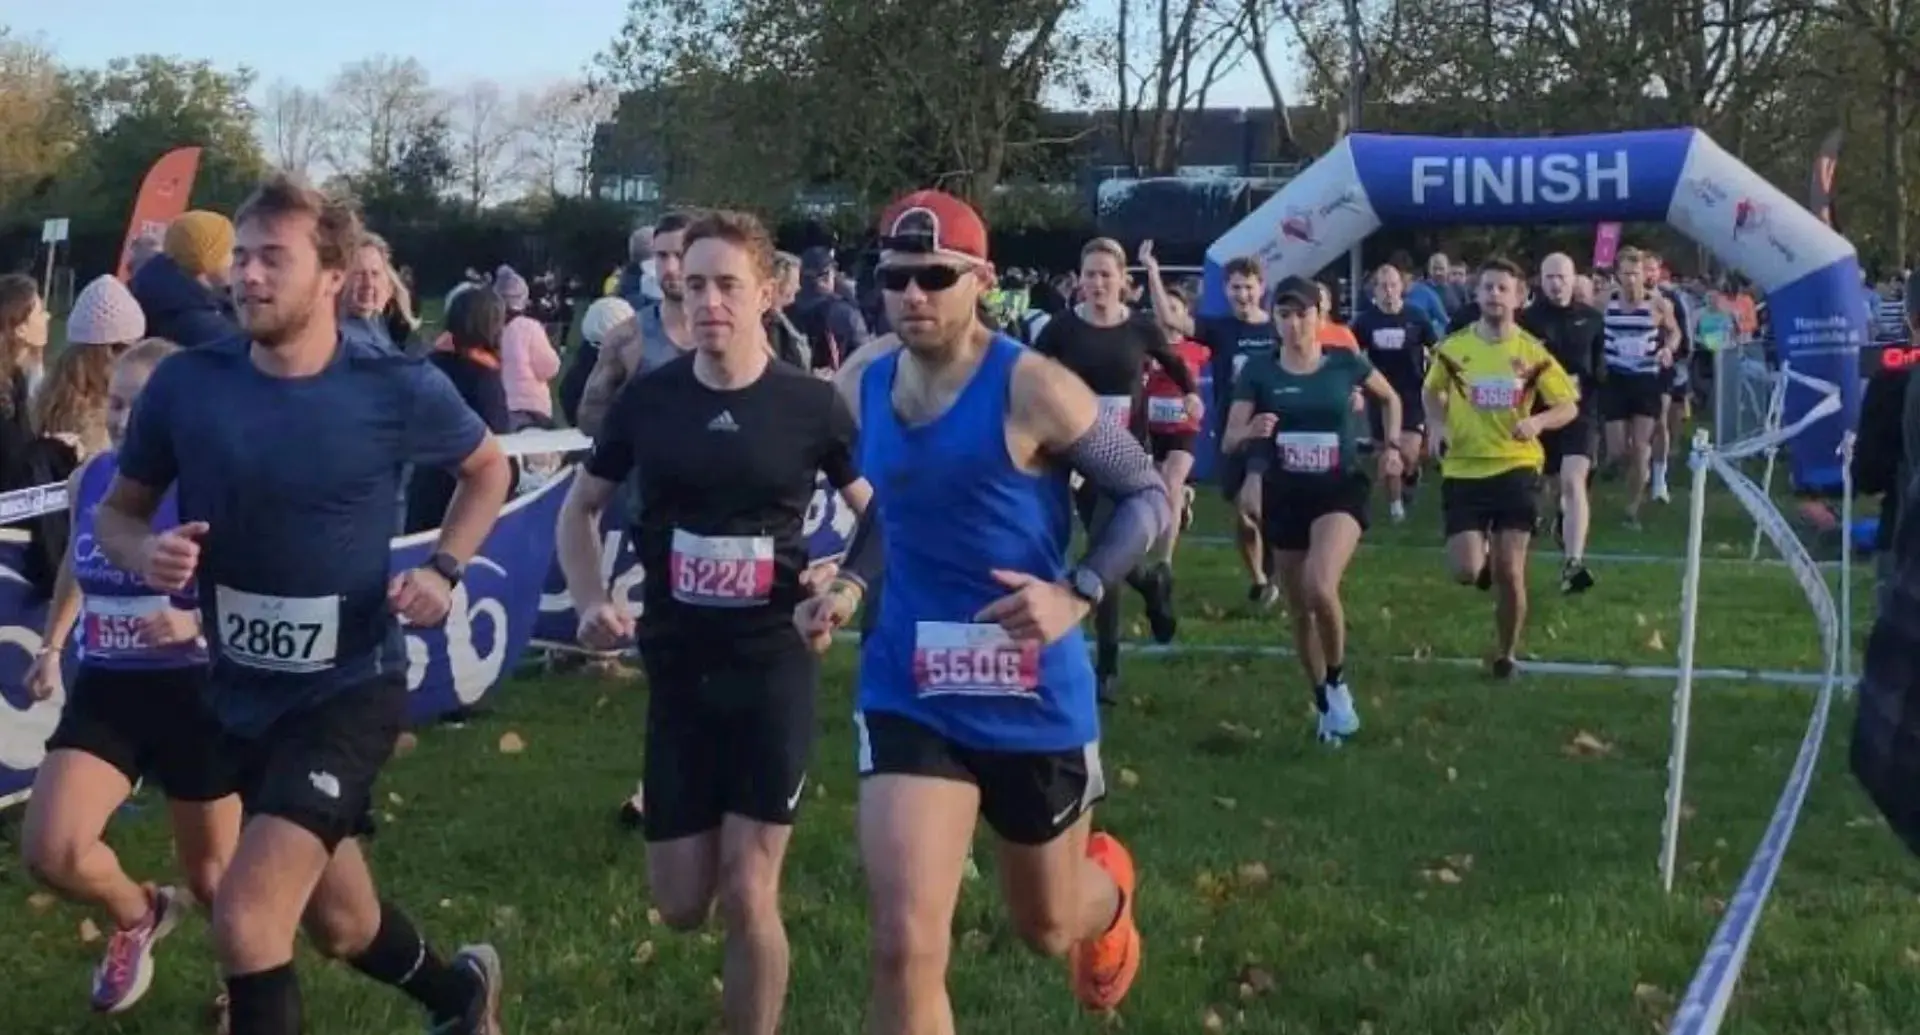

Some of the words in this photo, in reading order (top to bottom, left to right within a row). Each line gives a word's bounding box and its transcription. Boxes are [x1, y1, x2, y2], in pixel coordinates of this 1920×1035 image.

[1411, 150, 1629, 205] FINISH
[679, 556, 756, 597] 5224
[99, 616, 148, 649] 552
[226, 612, 323, 660] 2867
[925, 647, 1021, 685] 5506
